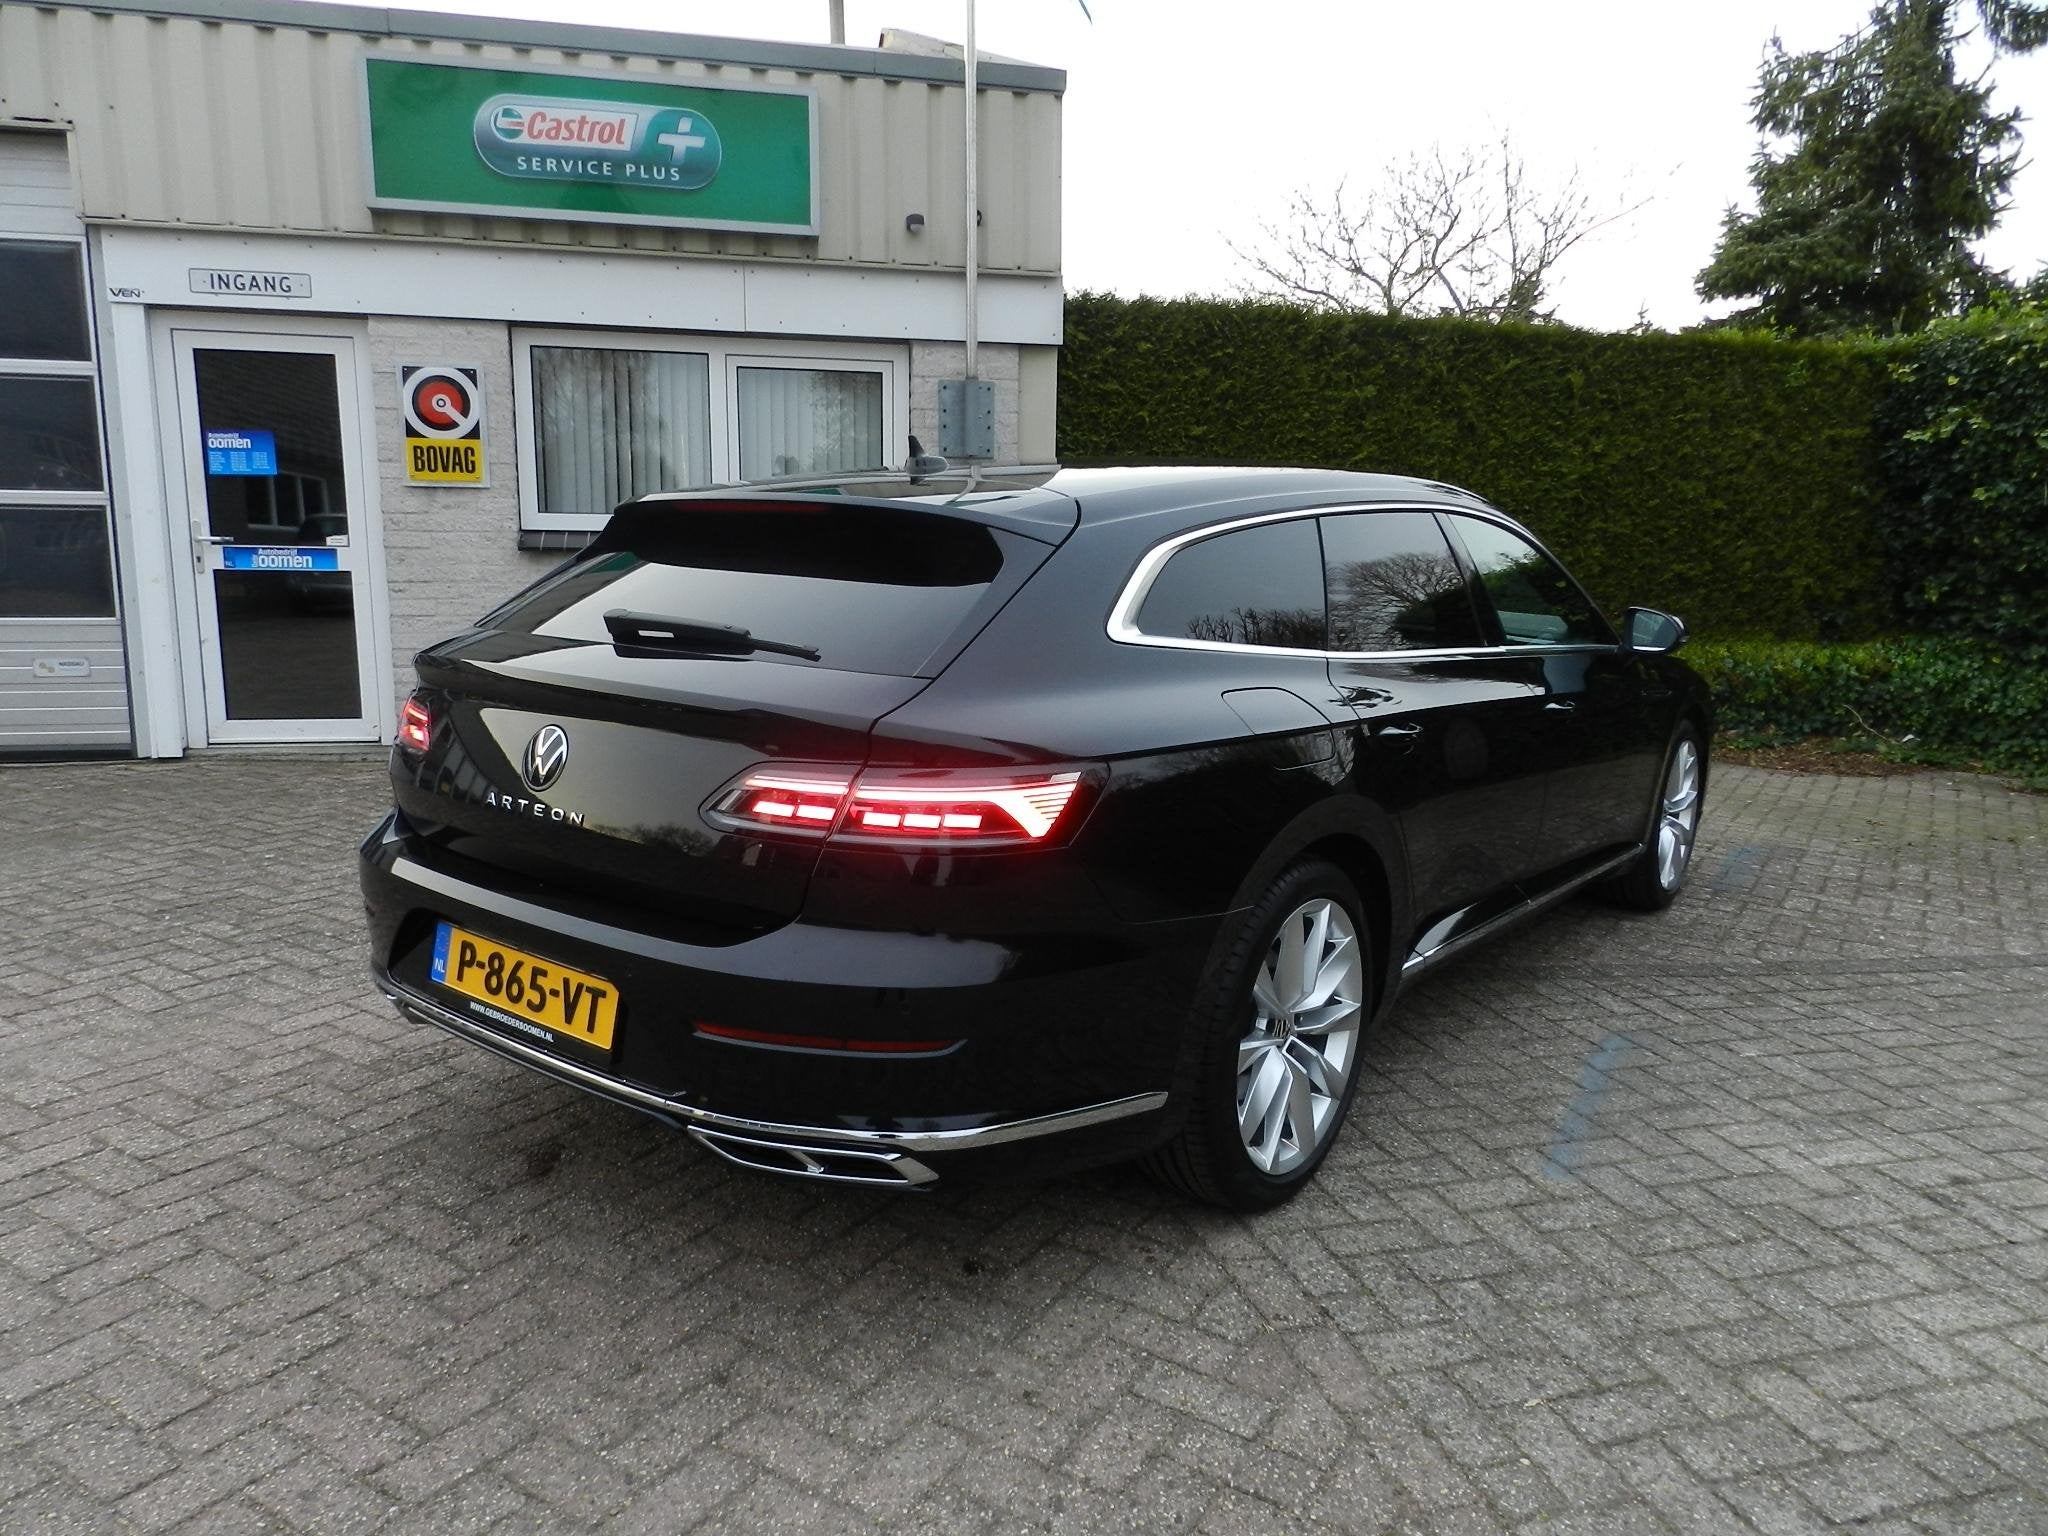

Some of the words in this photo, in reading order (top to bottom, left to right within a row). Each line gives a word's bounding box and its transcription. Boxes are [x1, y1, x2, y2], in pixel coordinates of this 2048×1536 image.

[527, 111, 626, 145] Castrol
[517, 156, 613, 176] SERVICE
[625, 163, 681, 181] PLUS
[209, 272, 293, 294] INGANG
[208, 438, 252, 449] oomen
[413, 445, 477, 474] BOVAG
[258, 555, 313, 569] oomen
[485, 791, 585, 826] ARTEON
[434, 958, 446, 974] NL
[456, 939, 607, 1034] P-865-VT
[469, 1000, 555, 1043] WWW.GEBROEDERSOOMEN.NL
